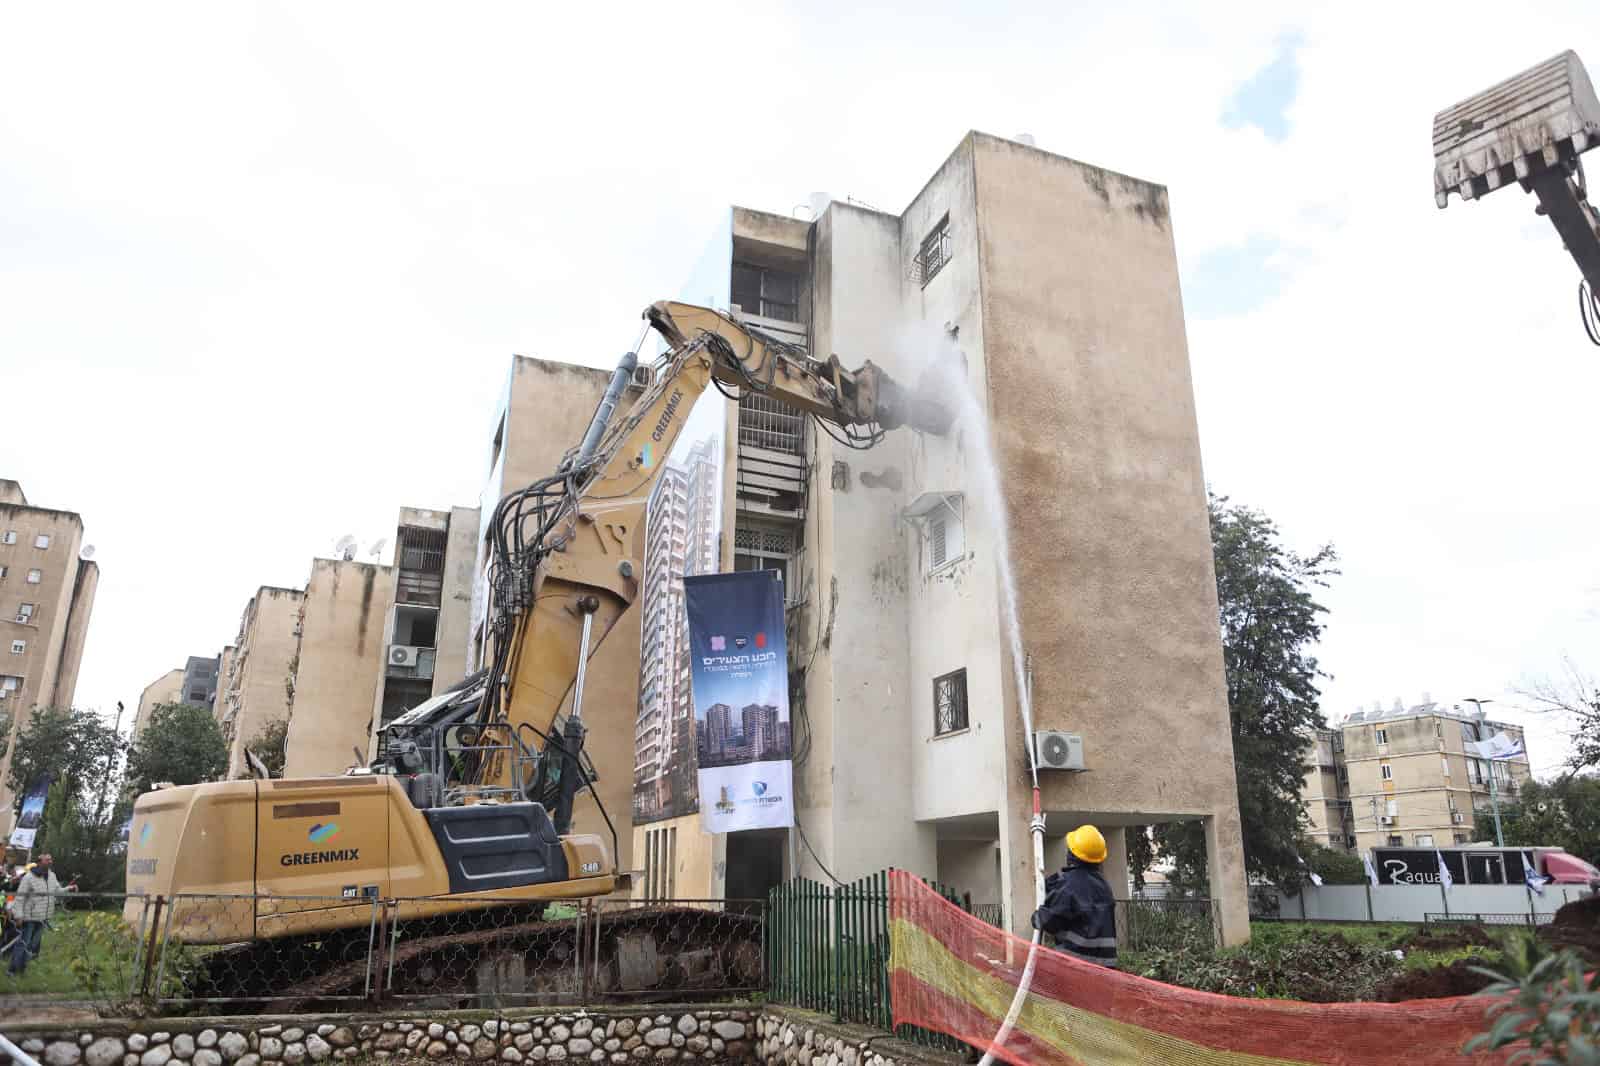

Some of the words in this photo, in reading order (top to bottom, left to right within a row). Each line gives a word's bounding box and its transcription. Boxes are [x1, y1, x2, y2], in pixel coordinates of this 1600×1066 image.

[652, 388, 683, 442] GREENMIX
[703, 655, 749, 665] הצעירים
[751, 651, 777, 662] רובע
[280, 848, 359, 867] GREENMIX
